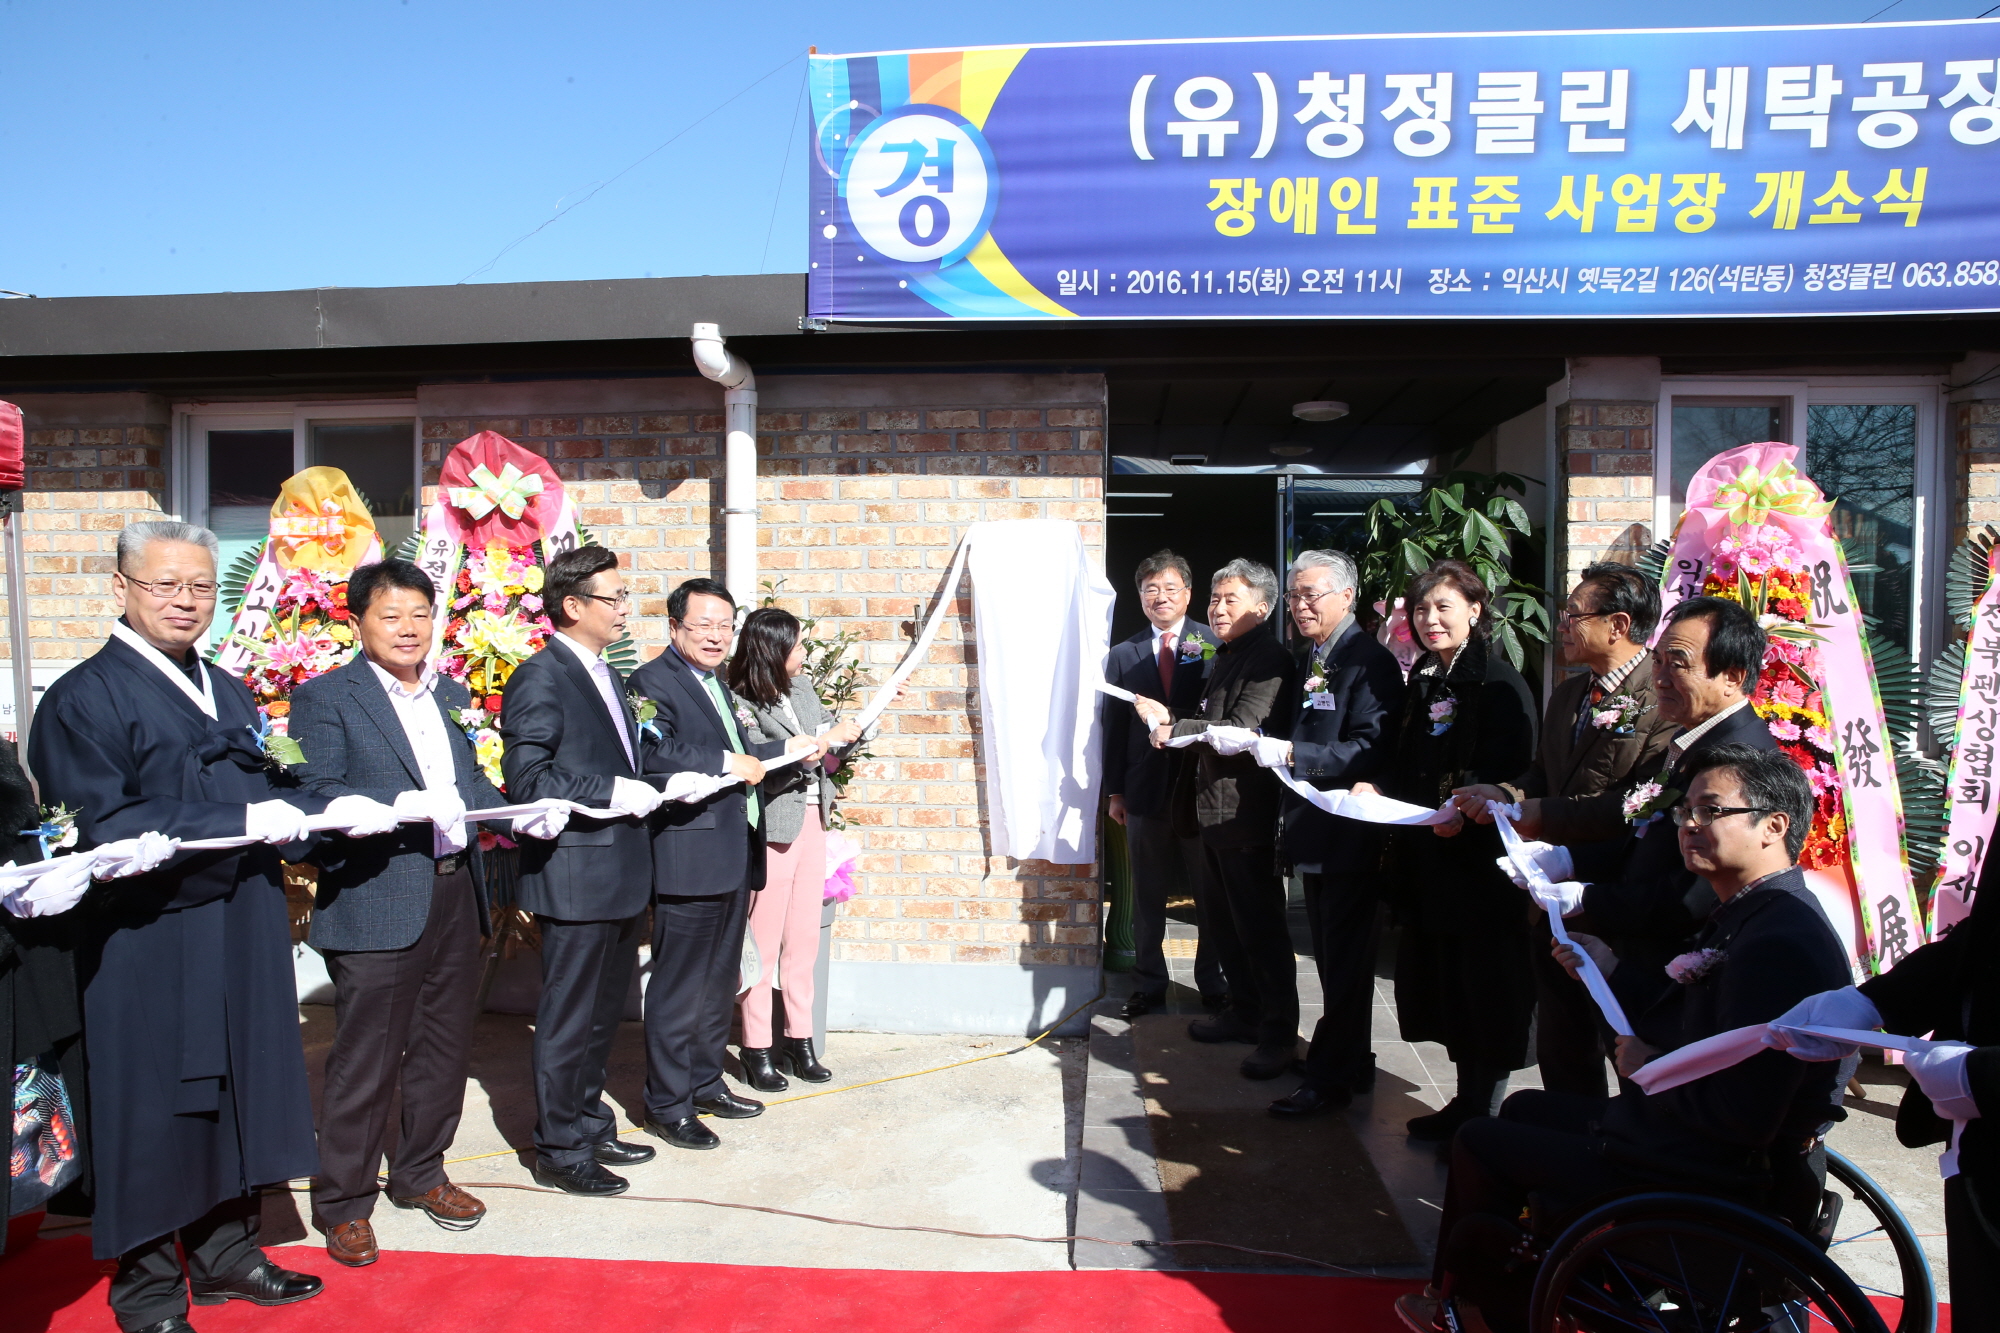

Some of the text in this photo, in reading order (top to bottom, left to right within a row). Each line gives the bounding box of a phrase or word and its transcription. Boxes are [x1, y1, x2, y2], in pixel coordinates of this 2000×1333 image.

[1129, 58, 2000, 161] (유)청정클린 세탁공장
[873, 137, 957, 247] 경
[1206, 167, 1929, 237] 장애인 표준 사업장 개소식
[1056, 269, 1099, 296] 일시
[1126, 267, 1291, 296] 2016.11.15(화)
[1299, 268, 1345, 294] 오전
[1354, 268, 1403, 295] 11시
[1427, 267, 1472, 295] 장소
[1502, 267, 1569, 295] 익산시
[1577, 266, 1660, 294] 옛둑2길
[1668, 264, 1795, 294] 126(석탄동)
[1803, 262, 1897, 292] 청정클린
